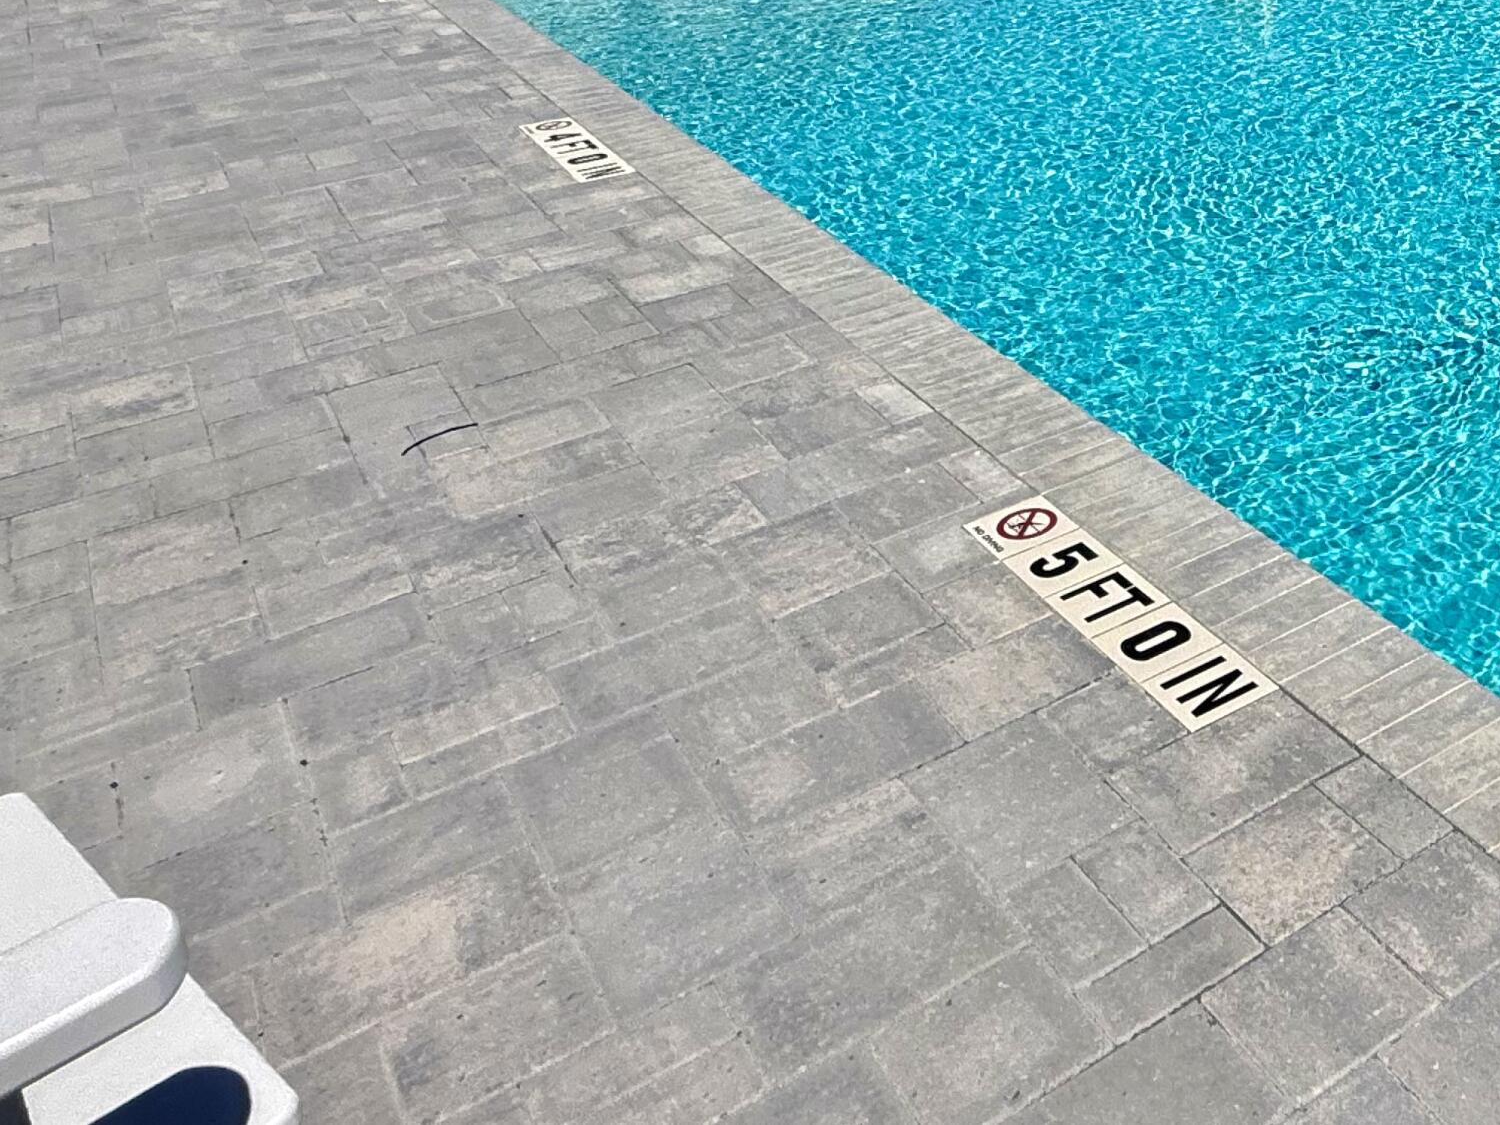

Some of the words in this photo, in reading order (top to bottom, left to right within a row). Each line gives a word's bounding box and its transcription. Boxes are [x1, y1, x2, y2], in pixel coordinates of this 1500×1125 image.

[544, 133, 582, 143] 4
[550, 139, 599, 155] FT
[567, 153, 609, 165] 0
[577, 162, 626, 180] IN
[1029, 542, 1099, 579] 5
[1059, 571, 1155, 624] FT
[1120, 620, 1192, 662] 0
[1160, 655, 1259, 718] IN
